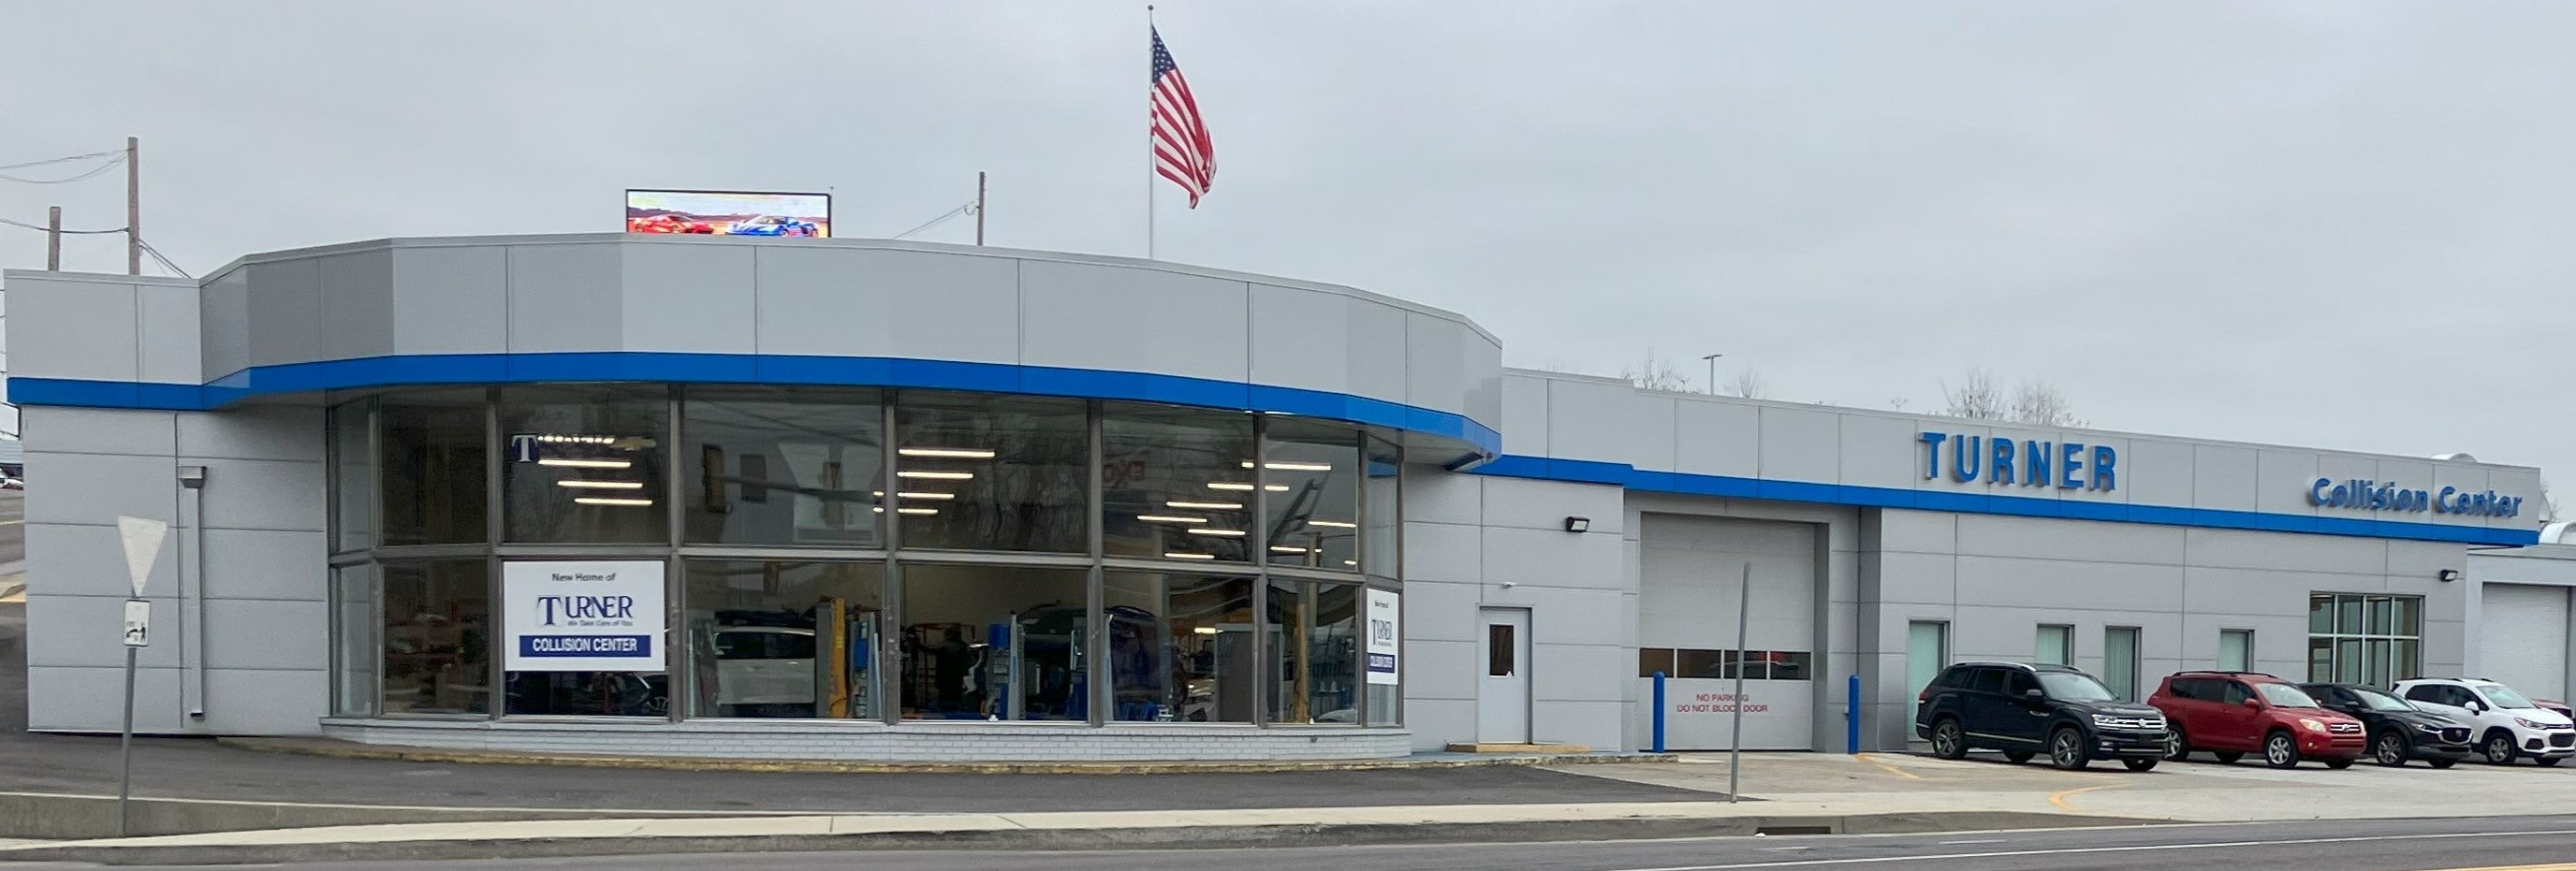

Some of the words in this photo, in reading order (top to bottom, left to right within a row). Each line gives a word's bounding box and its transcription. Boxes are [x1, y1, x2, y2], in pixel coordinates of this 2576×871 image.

[1919, 432, 2116, 491] TURNER
[2311, 477, 2428, 512] Collision
[2438, 486, 2523, 517] Center
[552, 573, 573, 582] New
[576, 573, 604, 582] Home
[606, 573, 617, 582] of
[537, 595, 635, 626] TURNER
[533, 638, 591, 652] COLLISION
[593, 638, 637, 652] CENTER
[1676, 704, 1690, 713] DO
[1691, 704, 1710, 713] NOT
[1712, 704, 1739, 713] BLOC
[1743, 704, 1768, 713] DOOR
